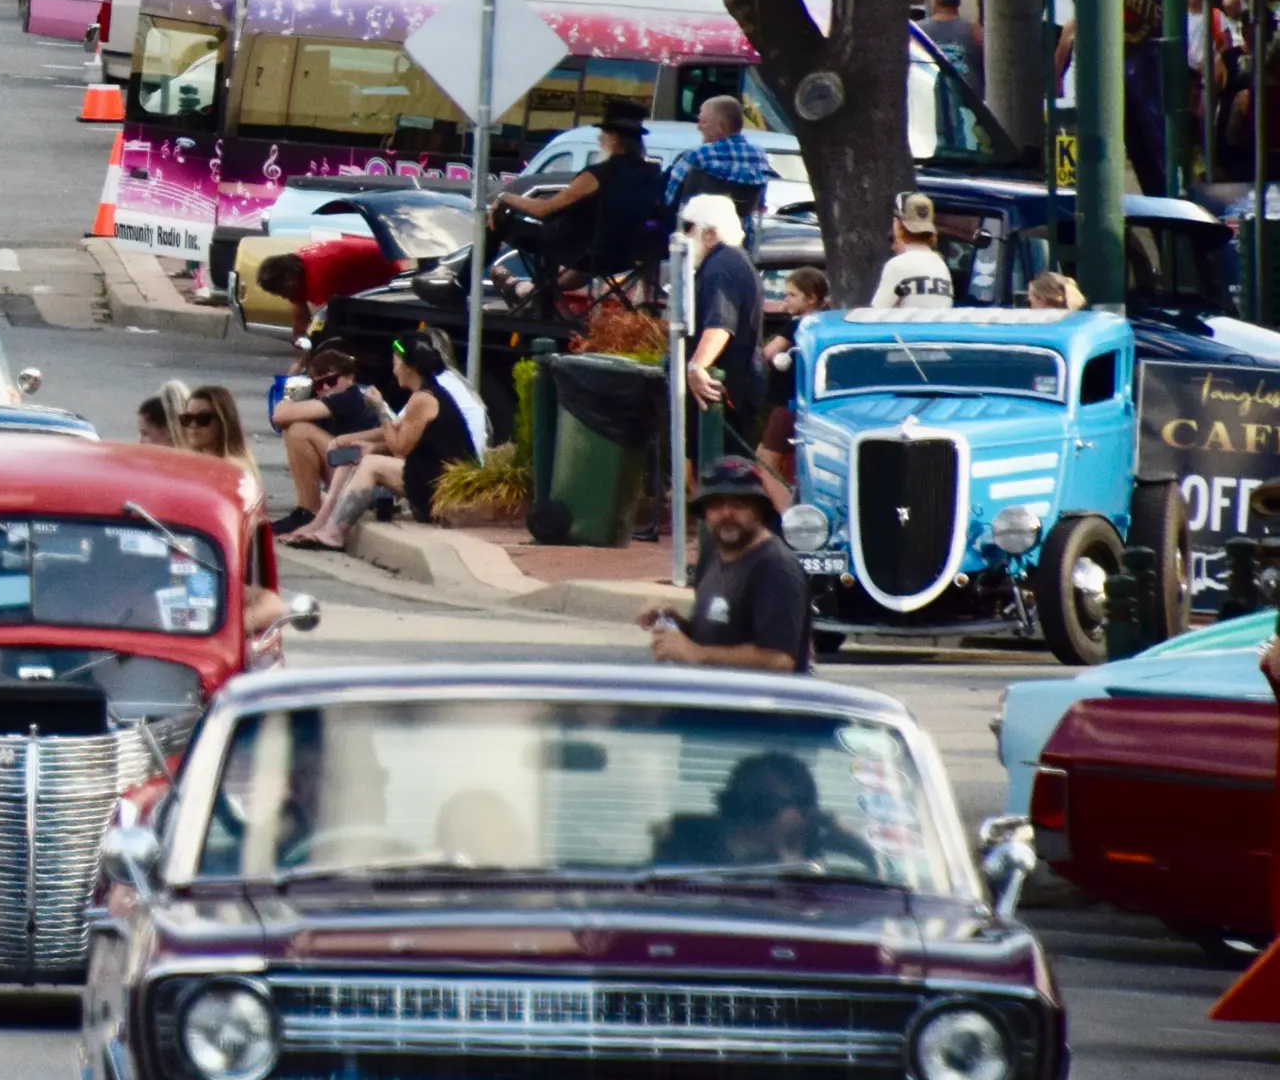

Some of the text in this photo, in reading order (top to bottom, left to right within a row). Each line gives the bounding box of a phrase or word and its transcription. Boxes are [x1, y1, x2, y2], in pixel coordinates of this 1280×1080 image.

[114, 222, 154, 249] ommunity
[157, 225, 181, 248] Radio
[1161, 418, 1280, 454] CAF
